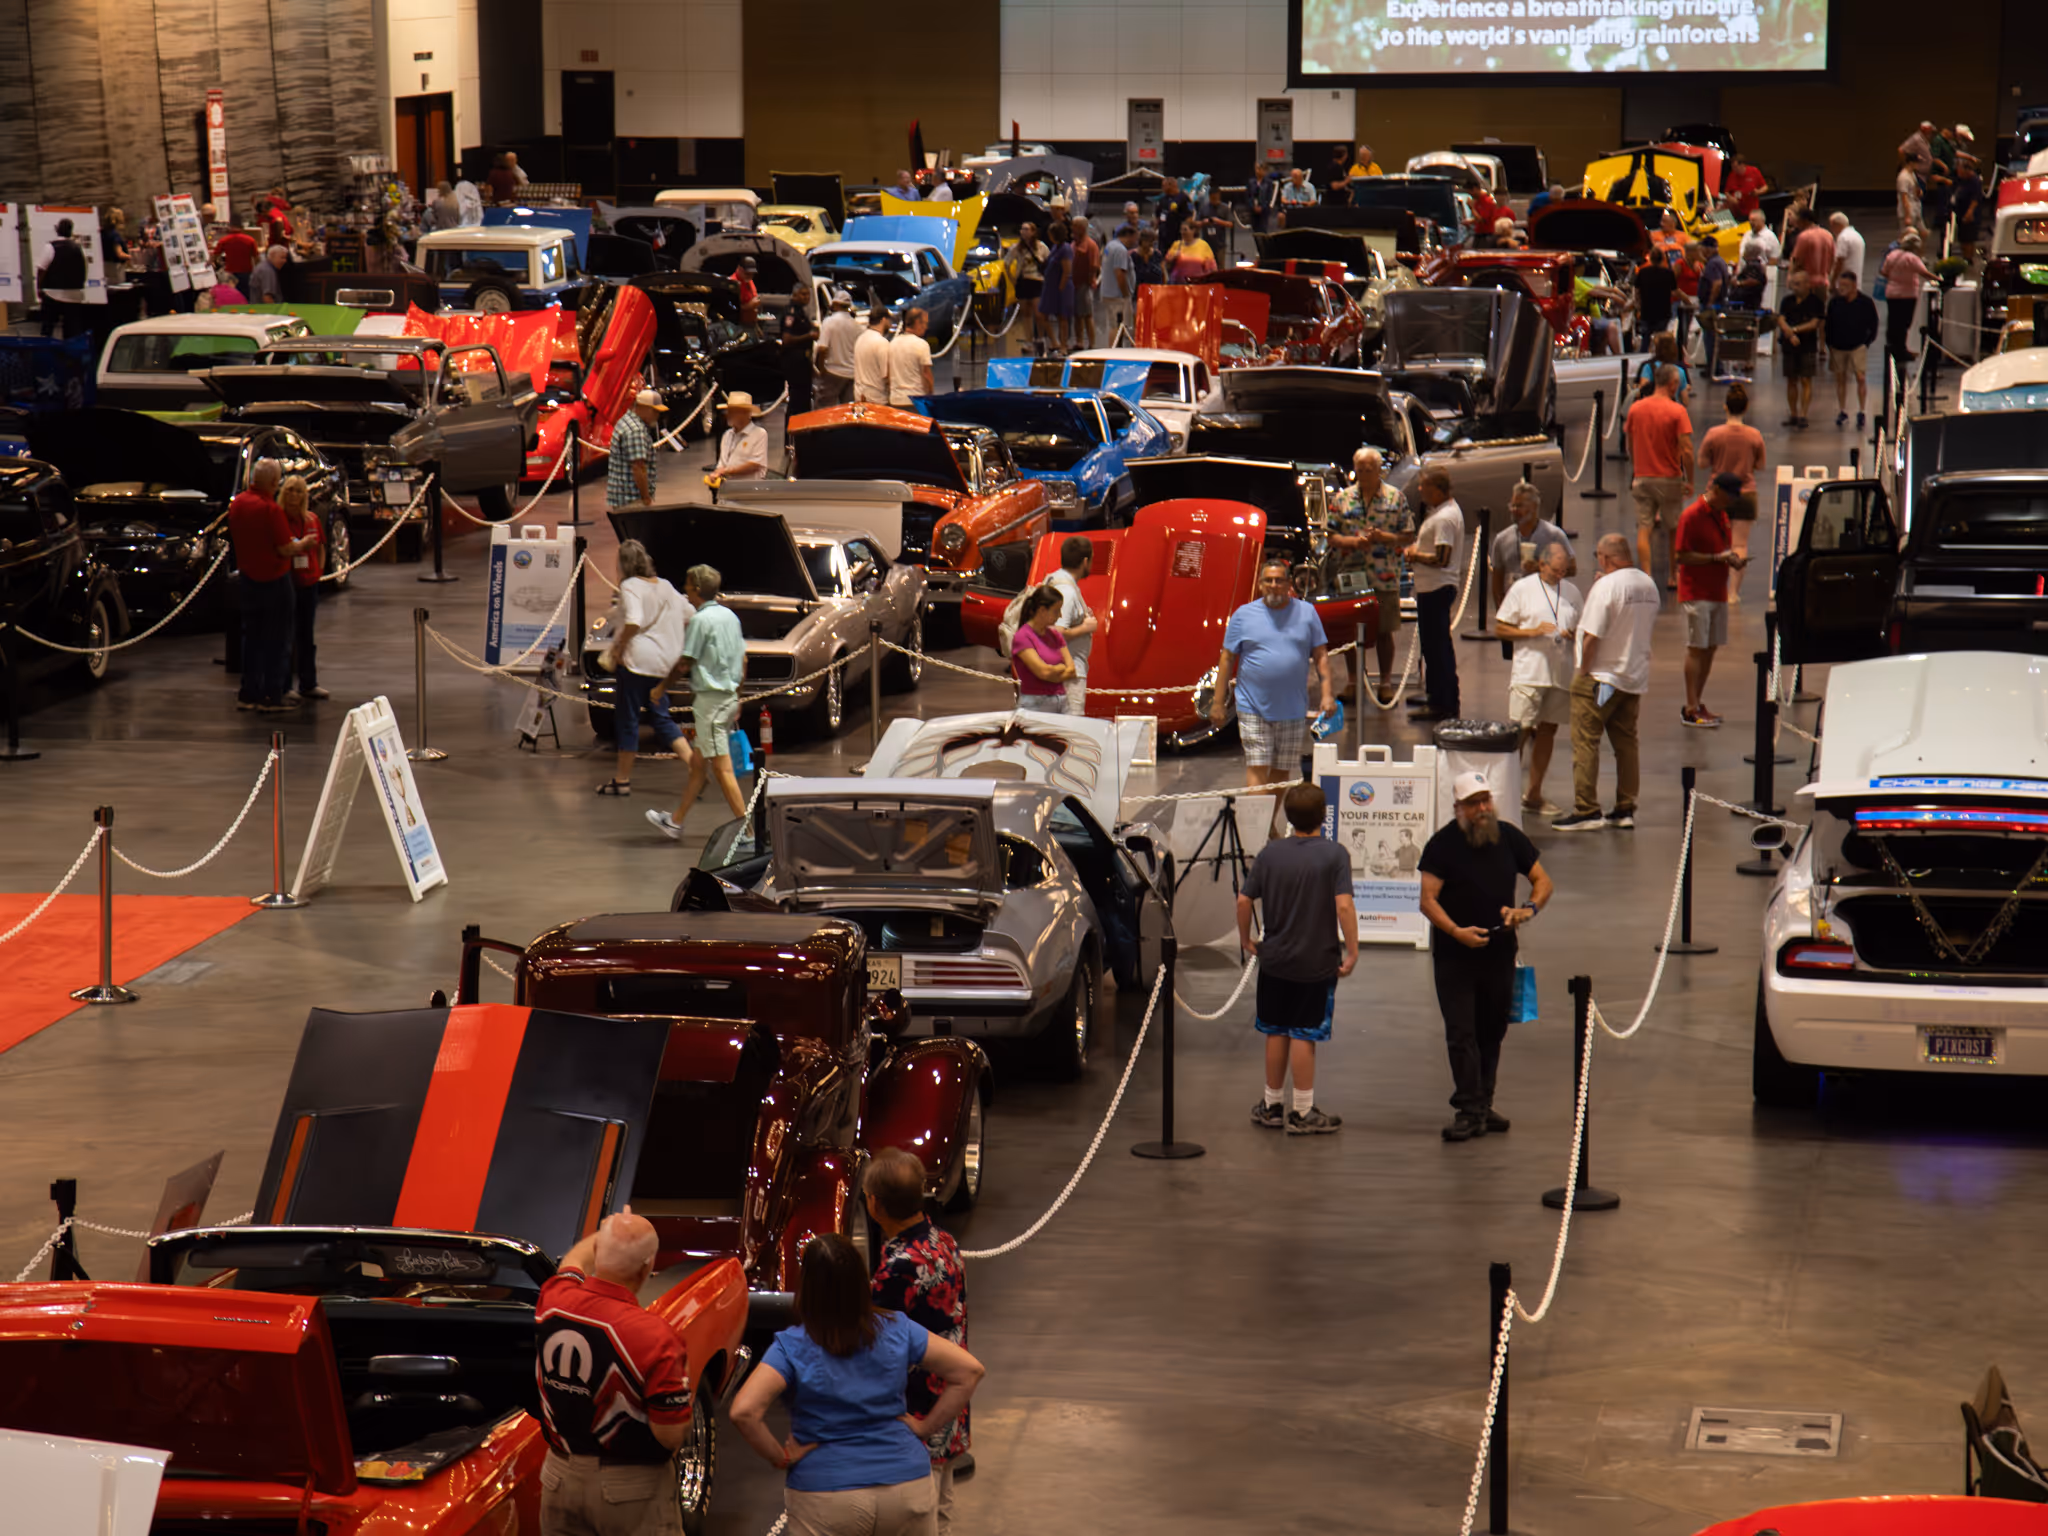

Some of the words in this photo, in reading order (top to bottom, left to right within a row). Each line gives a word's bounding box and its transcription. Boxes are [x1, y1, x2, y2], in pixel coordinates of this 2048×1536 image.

[1386, 0, 1509, 22] Experience
[1511, 2, 1526, 17] a
[1528, 0, 1674, 20] breathtaking
[1380, 27, 1404, 46] to
[1406, 25, 1443, 46] the
[1445, 25, 1526, 46] world's
[1528, 24, 1636, 48] vanishing
[1638, 23, 1760, 44] rainforests
[492, 560, 503, 596] Wheels
[493, 596, 501, 610] on
[489, 610, 501, 648] America
[1340, 810, 1368, 820] YOUR
[1372, 811, 1401, 820] FIRST
[1403, 812, 1425, 821] CAR
[544, 1376, 591, 1397] MOPAR
